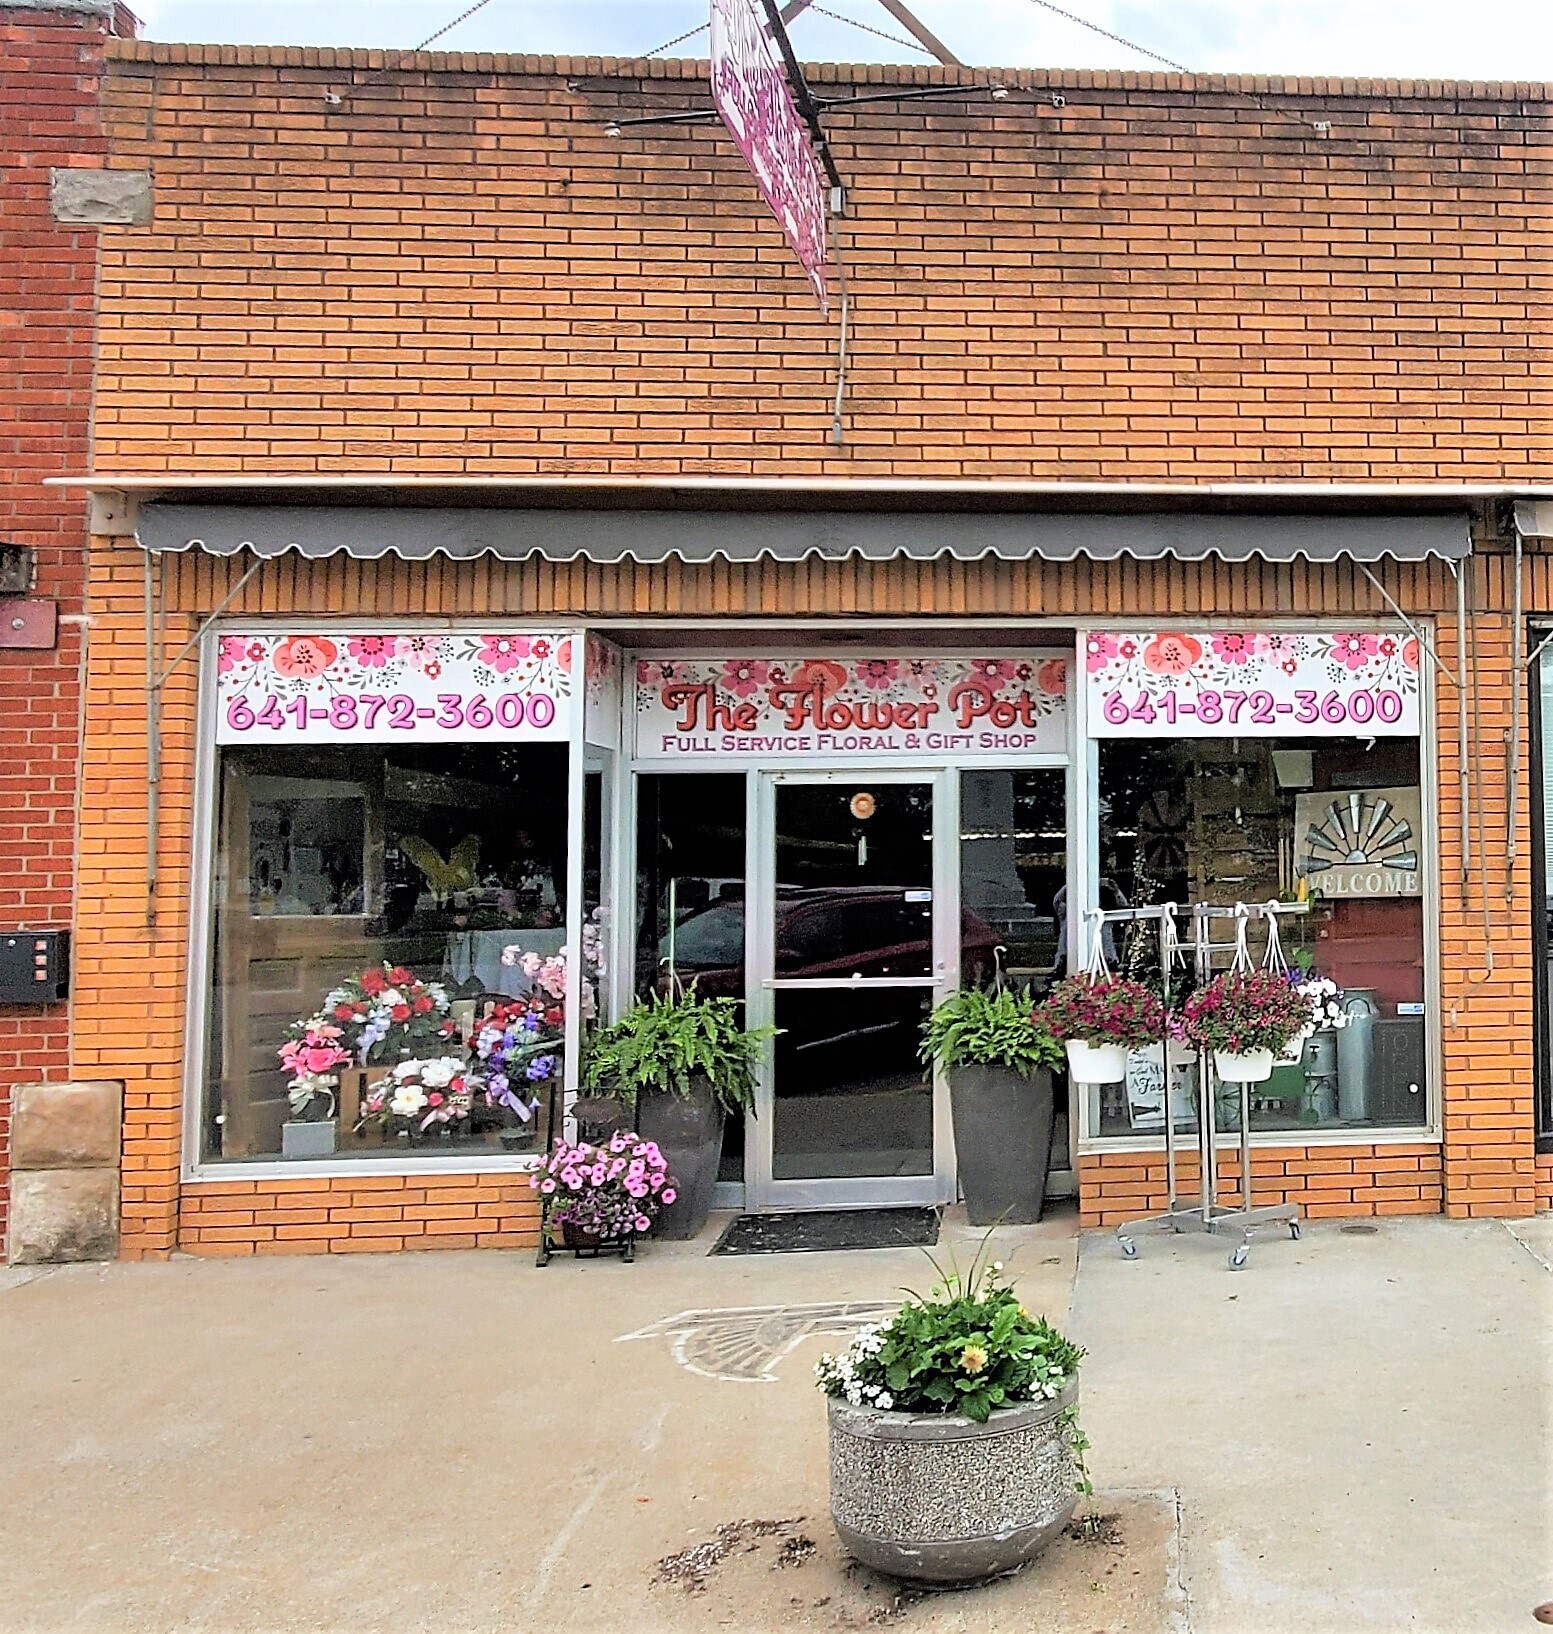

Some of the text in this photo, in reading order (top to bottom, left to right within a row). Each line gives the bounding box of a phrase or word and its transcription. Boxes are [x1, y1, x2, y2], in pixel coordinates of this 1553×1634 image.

[227, 693, 555, 730] 641-872-3600
[661, 681, 1036, 731] The Flower Pot
[1103, 689, 1402, 724] 641-872-3600
[662, 732, 1037, 752] FULL SERVICE FLORAL & GIFT SHOP
